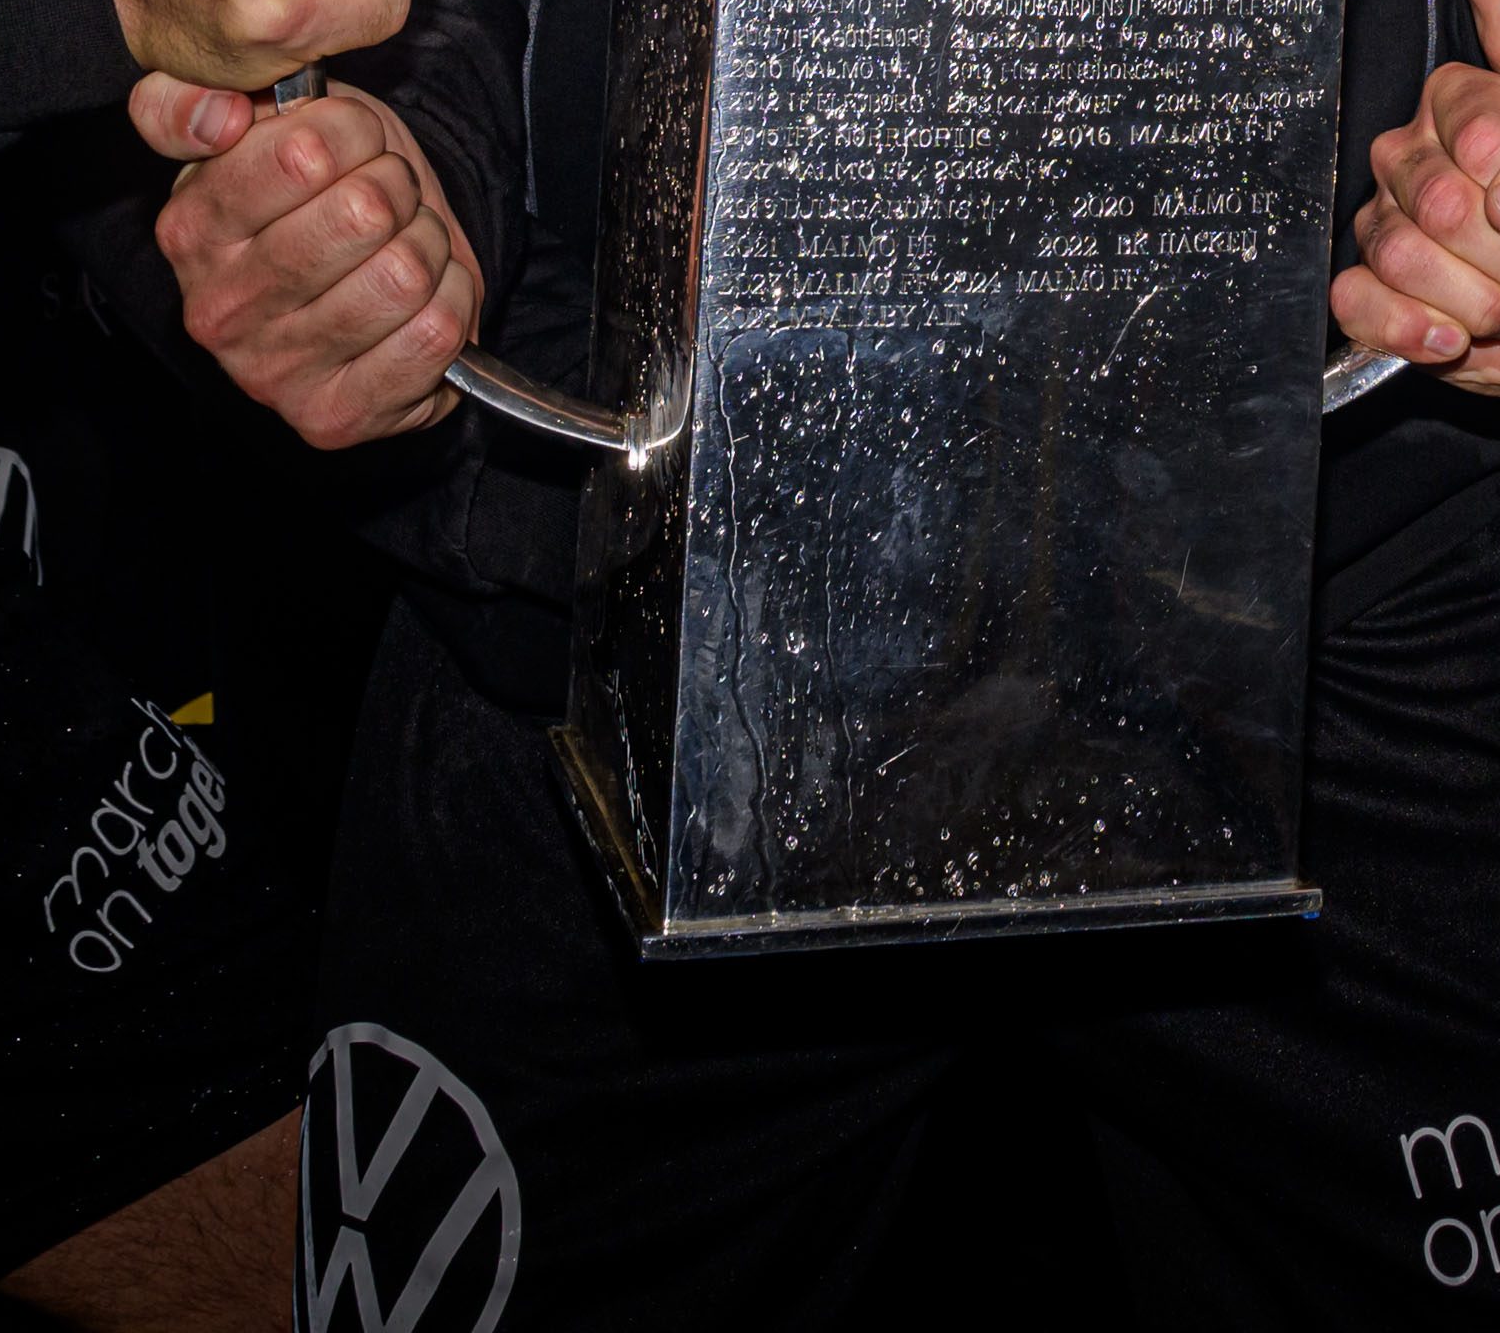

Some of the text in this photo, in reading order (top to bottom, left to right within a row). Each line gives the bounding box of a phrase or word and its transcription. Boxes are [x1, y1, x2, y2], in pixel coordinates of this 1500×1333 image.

[729, 58, 783, 79] 2010
[792, 55, 874, 80] MALMÖ
[729, 91, 780, 112] 2012
[726, 126, 780, 147] 2015
[1048, 126, 1112, 149] 2016
[934, 159, 989, 181] 2018
[1072, 195, 1135, 219] 2020
[722, 234, 778, 258] 2021
[797, 228, 897, 258] MALMÖ
[1037, 235, 1099, 258] 2022
[1114, 232, 1149, 256] BK
[792, 266, 891, 297] MALMÖ
[1015, 263, 1105, 293] MALMÖ
[789, 299, 918, 329] MJÄLLBY
[68, 734, 228, 973] on toge
